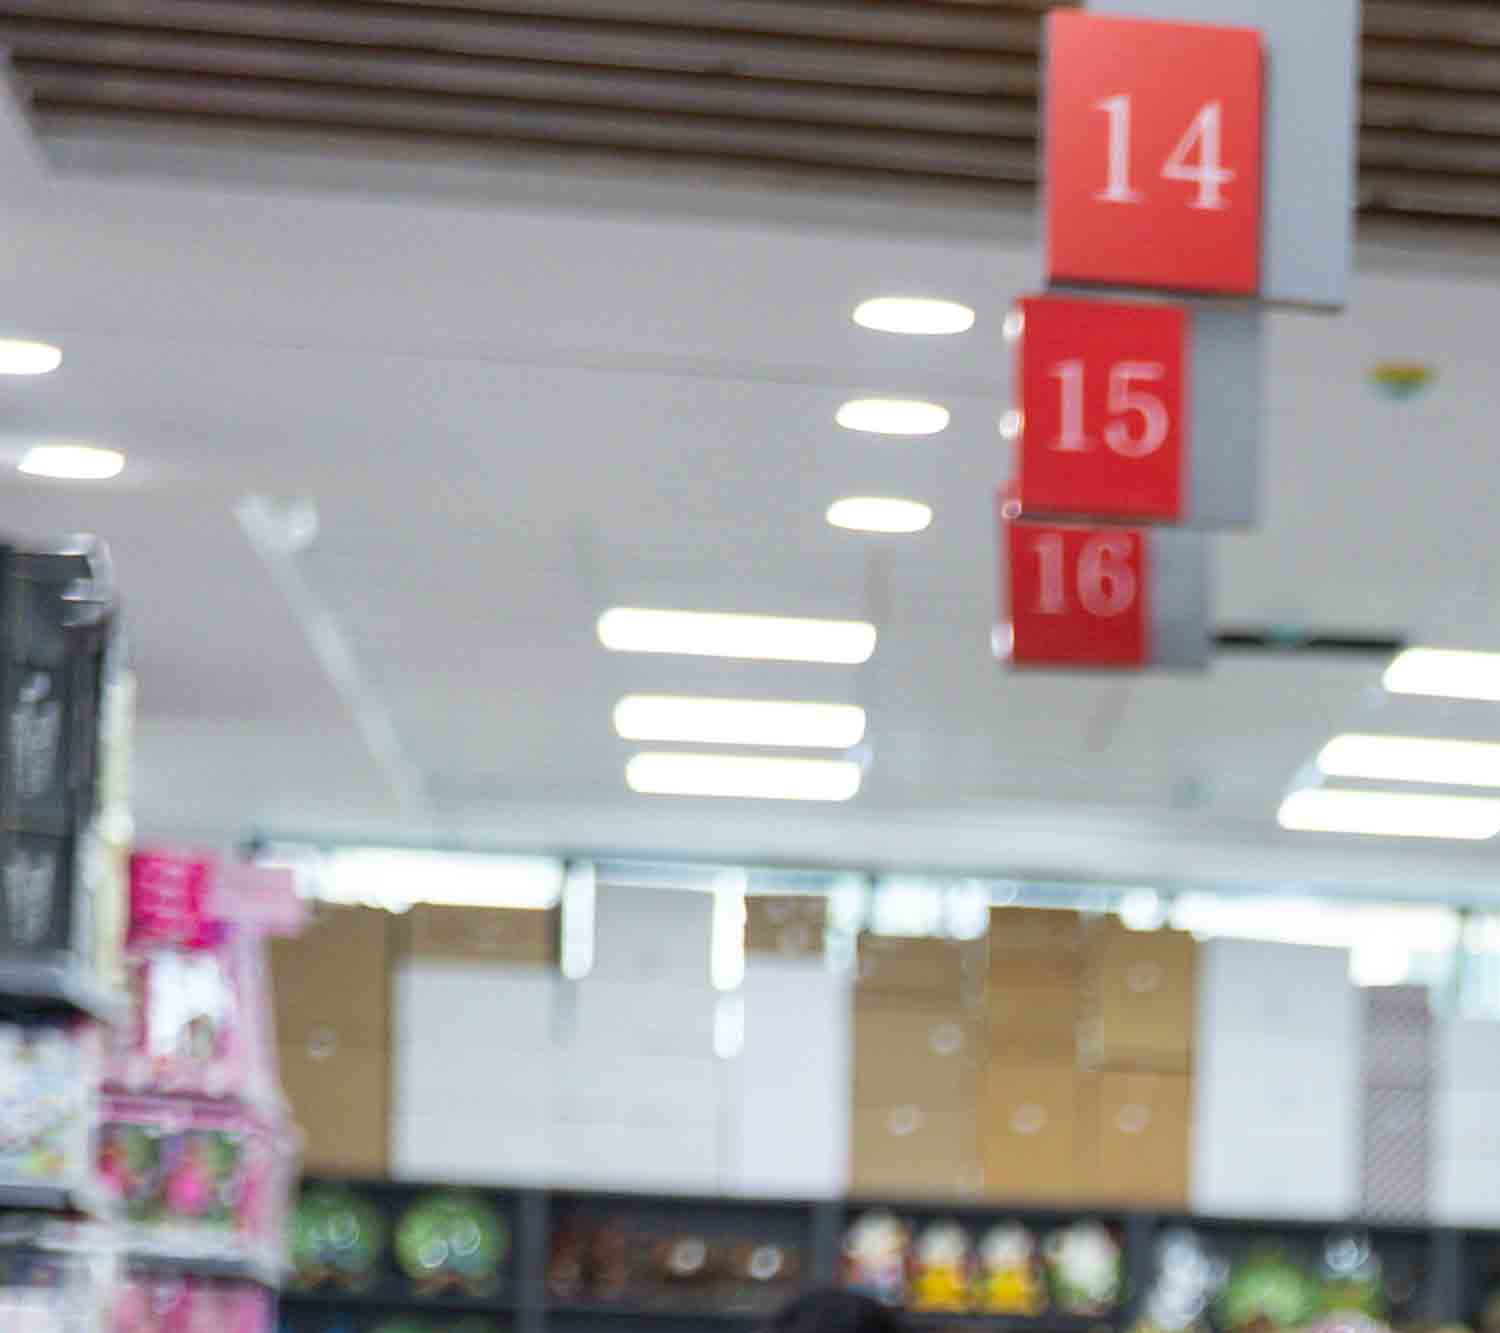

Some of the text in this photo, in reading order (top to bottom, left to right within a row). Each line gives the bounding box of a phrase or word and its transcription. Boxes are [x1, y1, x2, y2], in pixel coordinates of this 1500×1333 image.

[1091, 95, 1235, 210] 14
[1047, 357, 1170, 458] 15
[1030, 531, 1137, 617] 16
